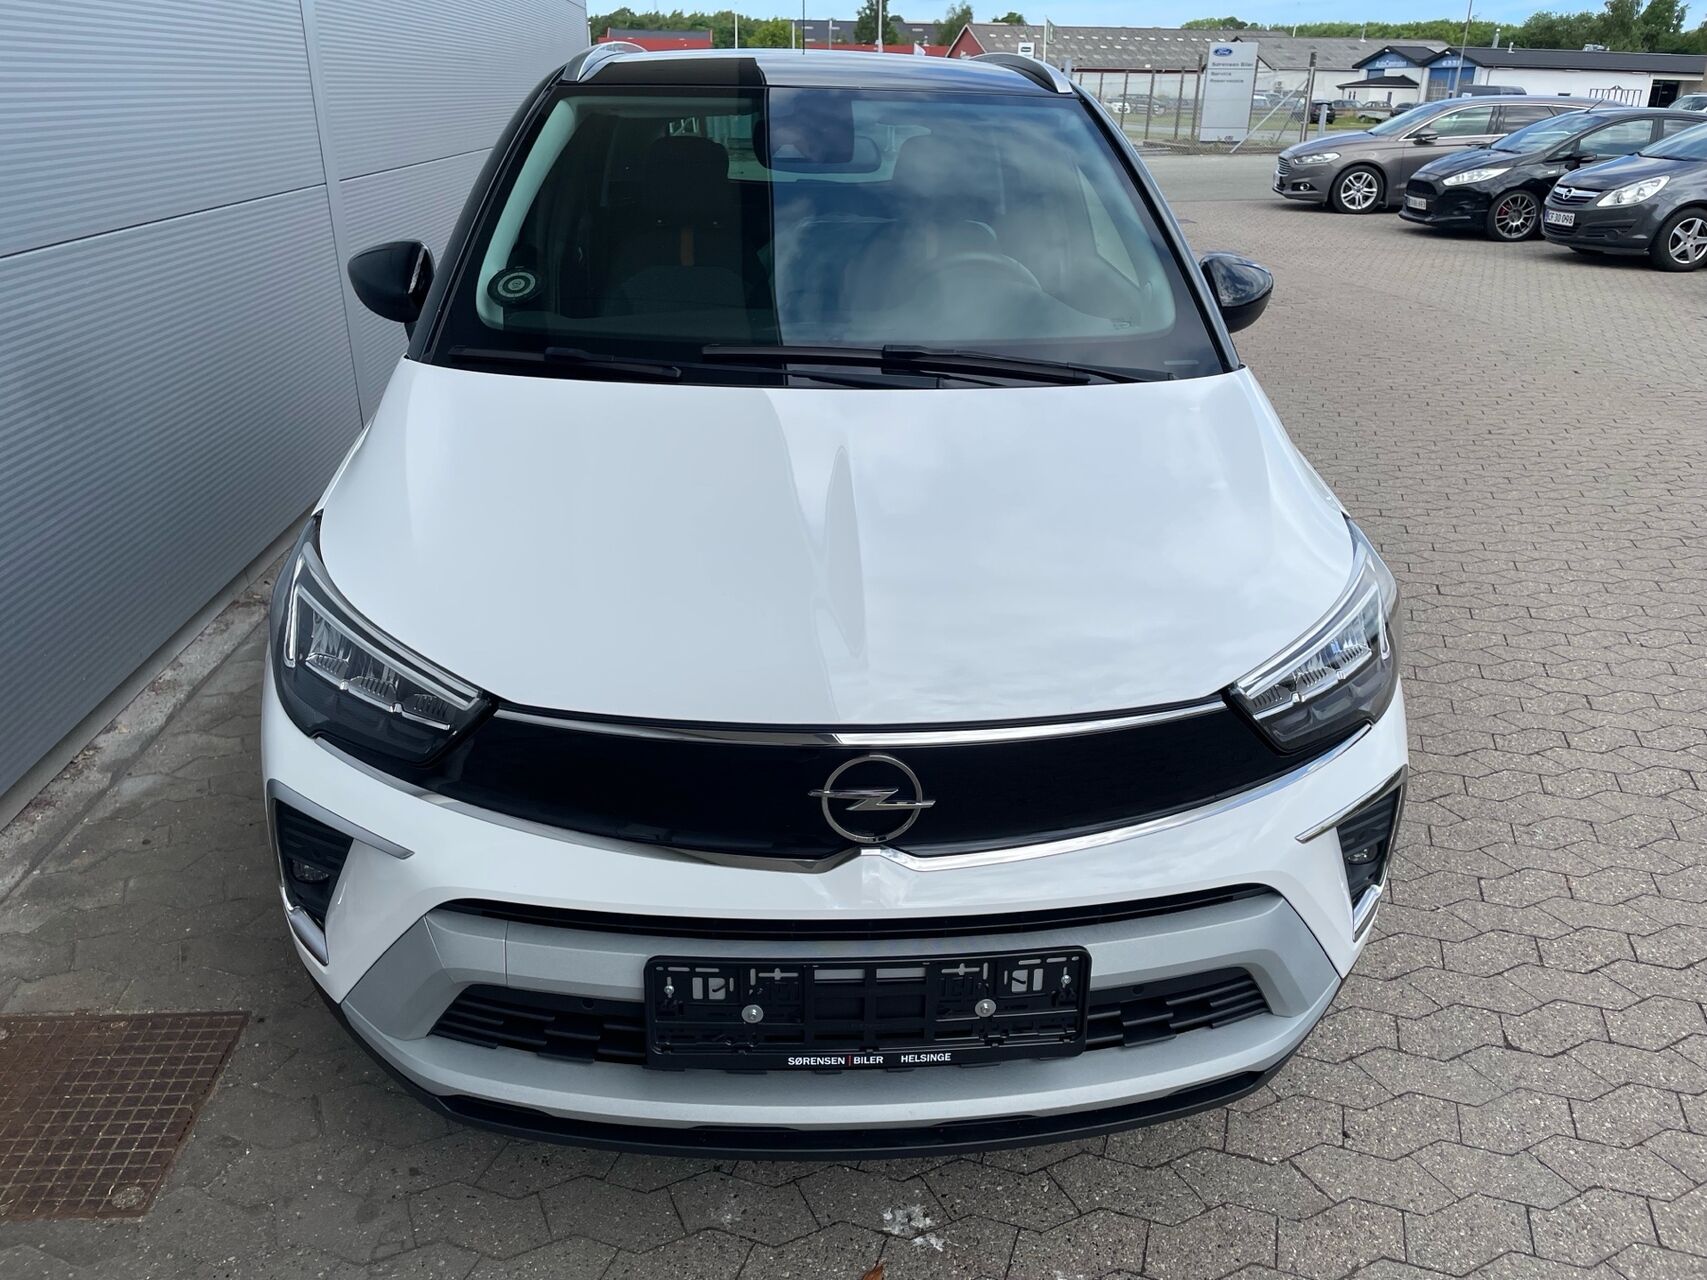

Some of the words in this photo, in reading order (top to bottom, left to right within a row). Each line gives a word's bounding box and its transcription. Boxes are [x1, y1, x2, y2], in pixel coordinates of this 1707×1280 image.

[1562, 214, 1573, 224] 098
[787, 1056, 845, 1065] SØRENSEN
[853, 1056, 884, 1064] BILER
[900, 1052, 952, 1063] HELSINGE
